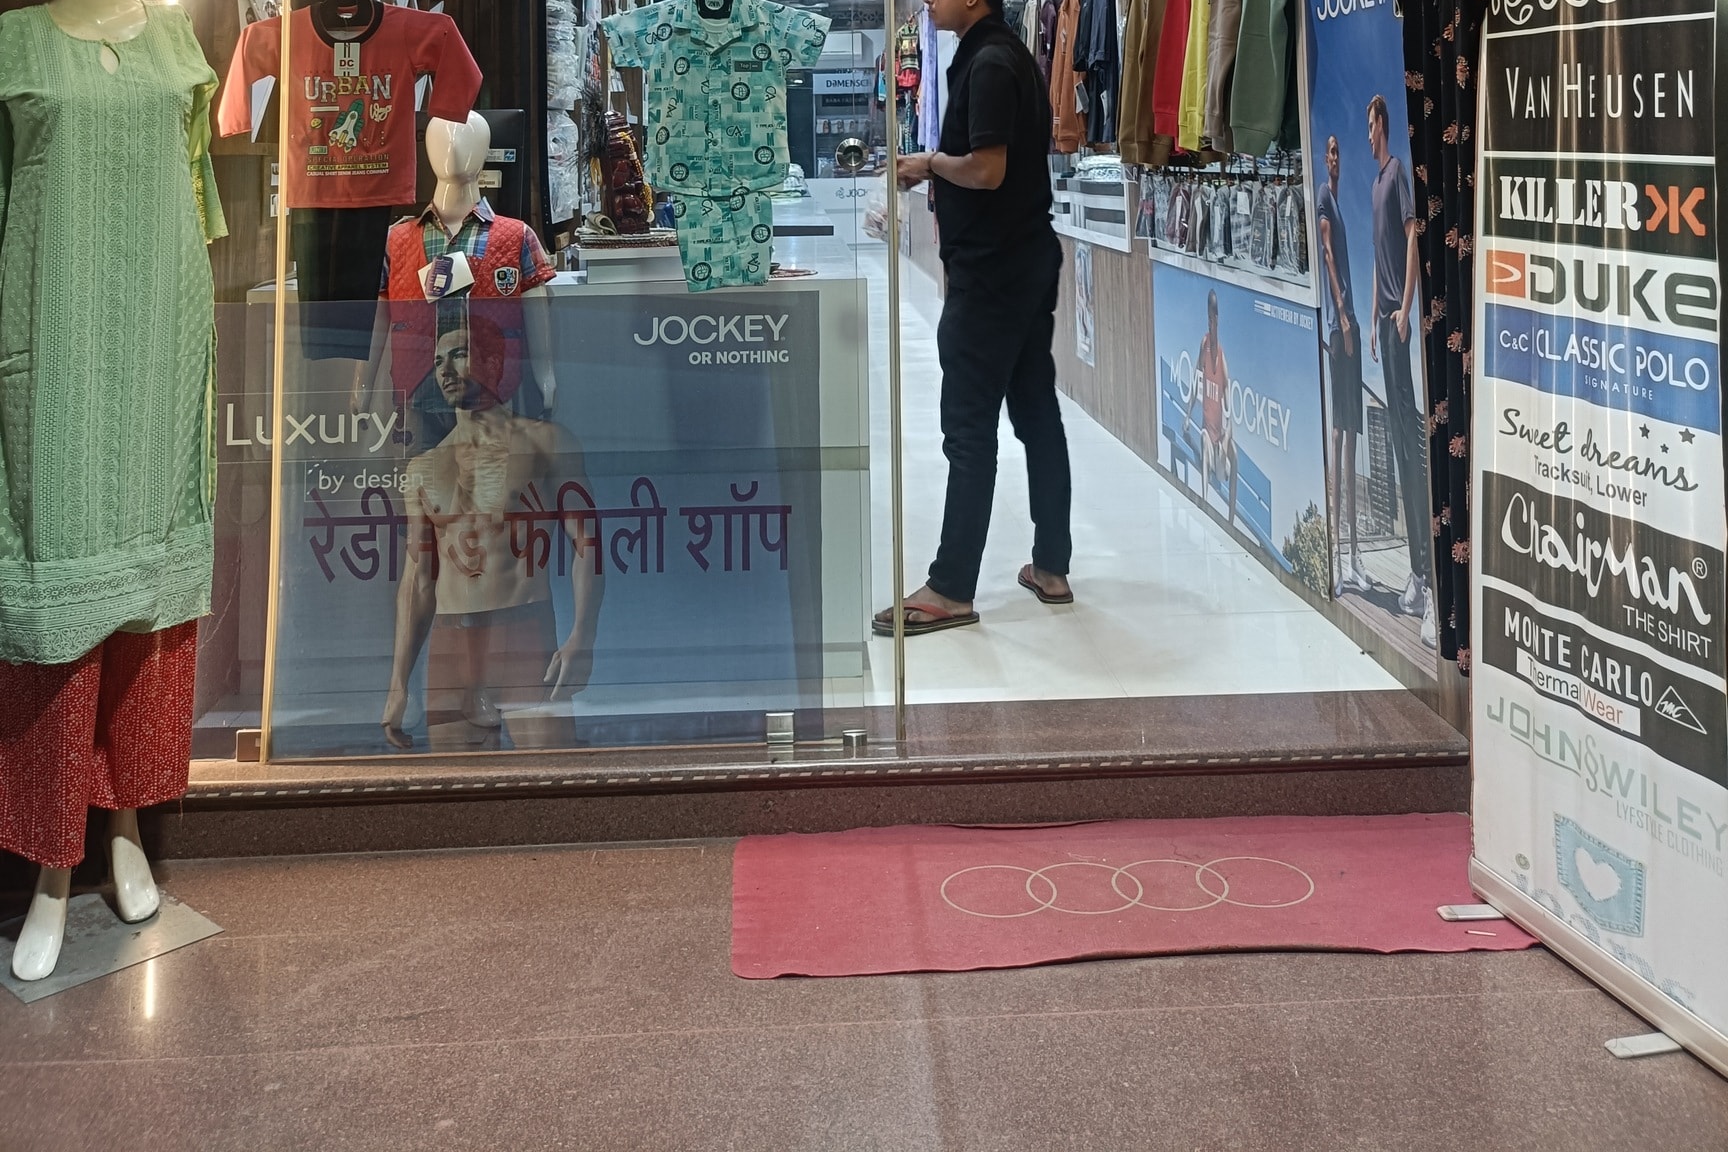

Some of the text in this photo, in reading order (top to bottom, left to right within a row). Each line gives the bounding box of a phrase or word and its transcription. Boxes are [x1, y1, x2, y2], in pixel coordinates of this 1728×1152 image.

[1499, 174, 1641, 232] KILLER
[633, 314, 789, 346] JOCKEY
[688, 349, 790, 365] OR NOTHING
[1499, 328, 1710, 391] C&C CLASSIC POLO
[1221, 377, 1291, 451] JOCKEY
[1584, 374, 1654, 401] SIGNATURE
[226, 402, 398, 453] Luxury
[1499, 407, 1699, 492] Sweet dreams
[318, 468, 345, 494] by
[1596, 475, 1648, 507] Lower
[504, 477, 668, 579] फैमिली
[680, 480, 792, 573] शॉप
[1504, 606, 1653, 707] MONTE CARLO
[1622, 604, 1712, 659] THE SHIRT
[1666, 829, 1724, 877] CLOTHING
